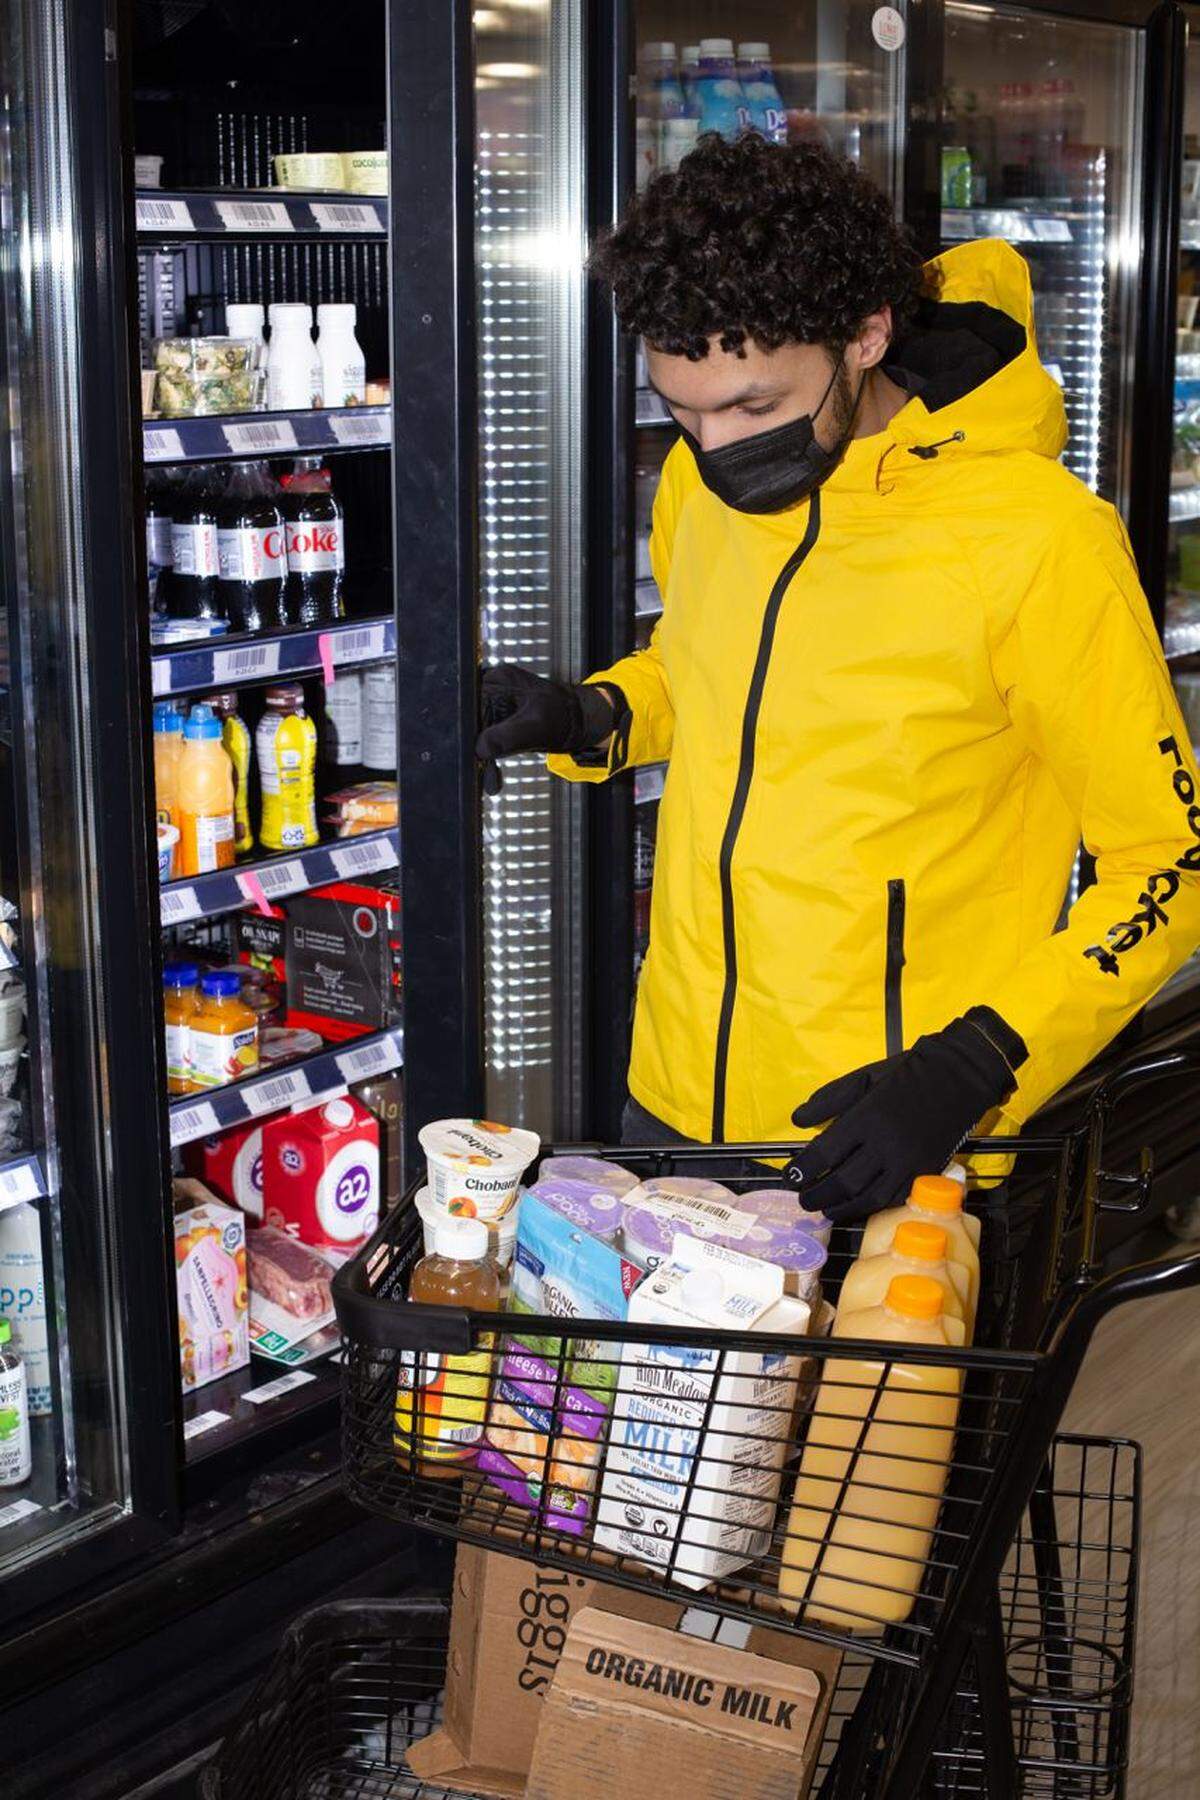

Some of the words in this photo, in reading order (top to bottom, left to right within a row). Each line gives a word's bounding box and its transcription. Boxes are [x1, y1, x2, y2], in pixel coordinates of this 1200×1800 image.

[340, 1173, 369, 1206] a2
[634, 1360, 661, 1388] High
[585, 1647, 715, 1707] ORGANIC
[721, 1685, 798, 1730] MILK
